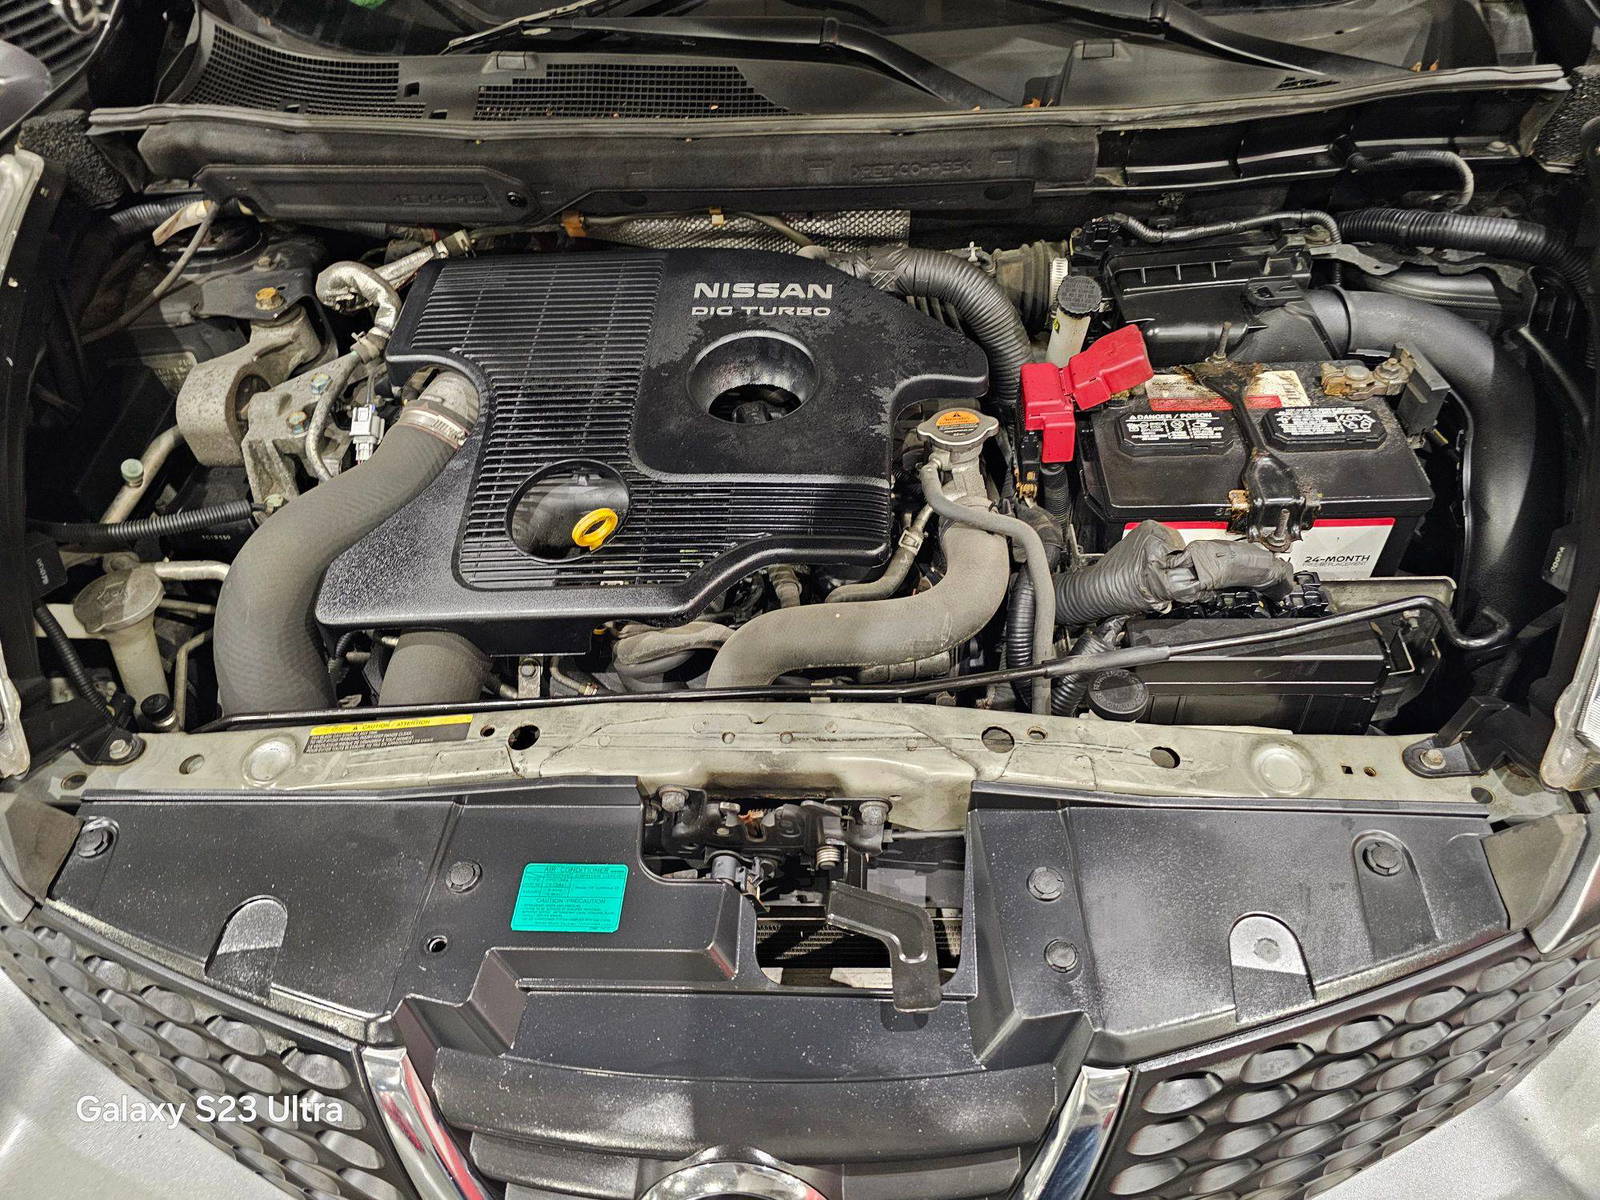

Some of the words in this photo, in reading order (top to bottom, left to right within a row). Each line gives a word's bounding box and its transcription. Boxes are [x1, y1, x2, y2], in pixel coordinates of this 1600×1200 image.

[693, 282, 833, 299] NISSAN
[691, 306, 733, 316] DIG
[740, 306, 831, 316] TURBO
[1304, 554, 1371, 563] 24-MONTH
[361, 723, 390, 731] CAUTION
